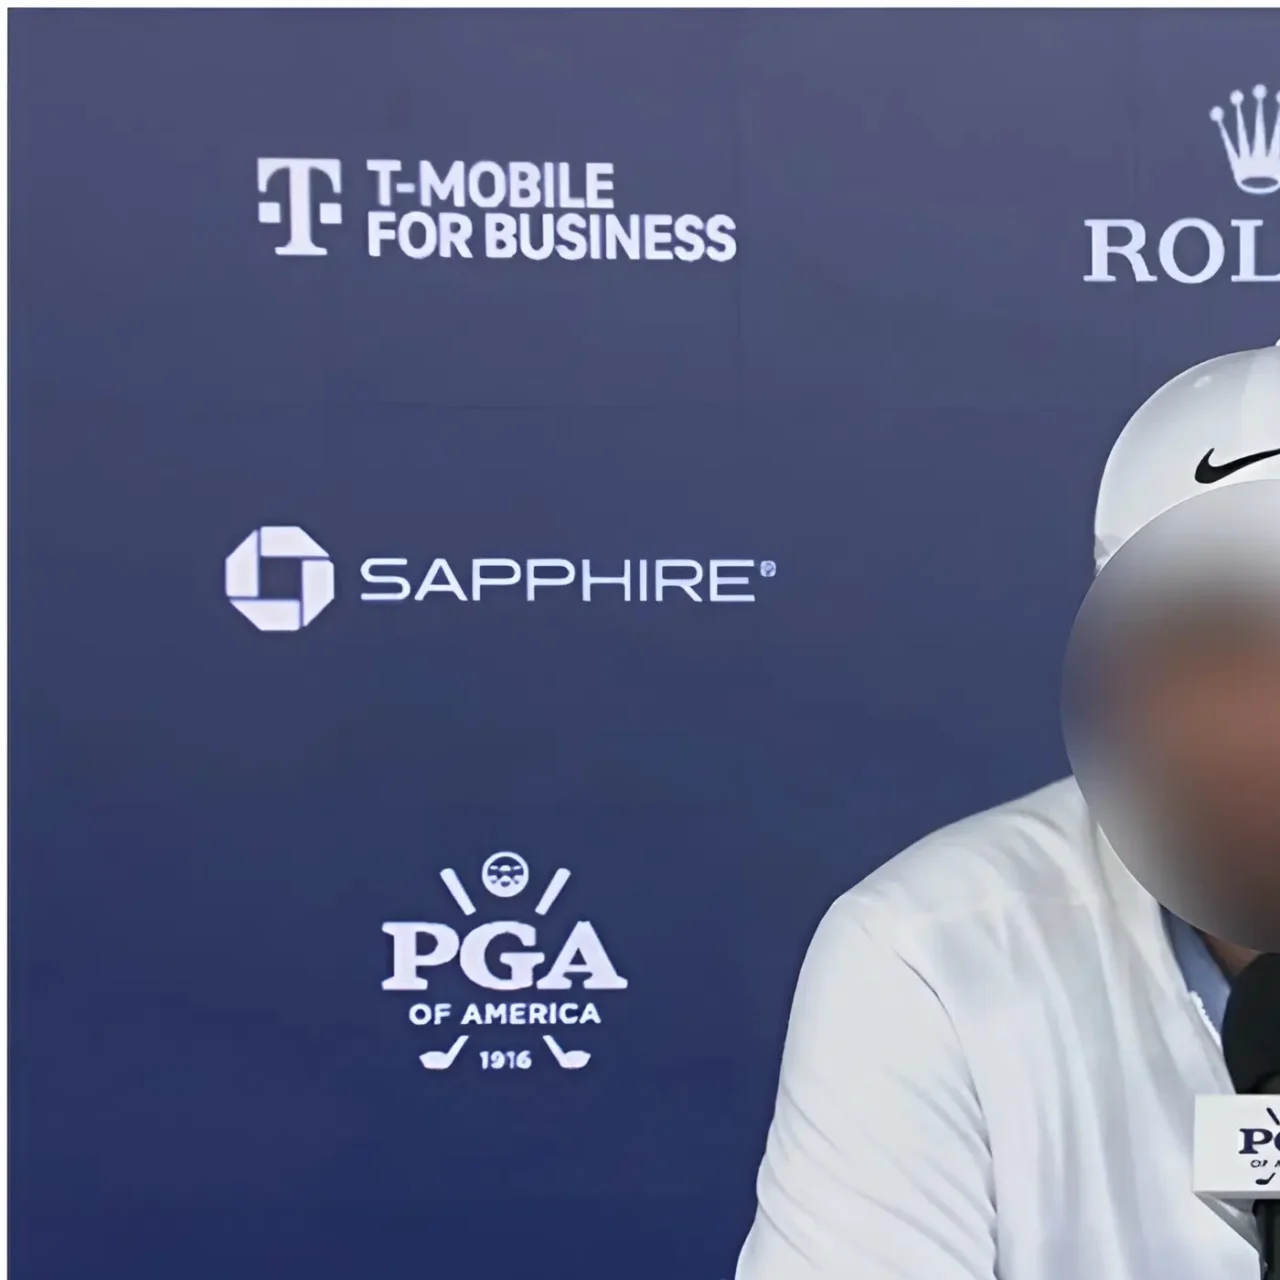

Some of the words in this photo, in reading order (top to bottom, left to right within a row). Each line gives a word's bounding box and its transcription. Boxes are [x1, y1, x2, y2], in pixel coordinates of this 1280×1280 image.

[366, 159, 615, 209] T-MOBILE
[367, 210, 473, 259] FOR
[484, 212, 737, 262] BUSINESS
[381, 920, 628, 991] PGA
[408, 1003, 452, 1026] OF
[460, 1002, 602, 1025] AMERICA
[479, 1050, 532, 1070] 1916
